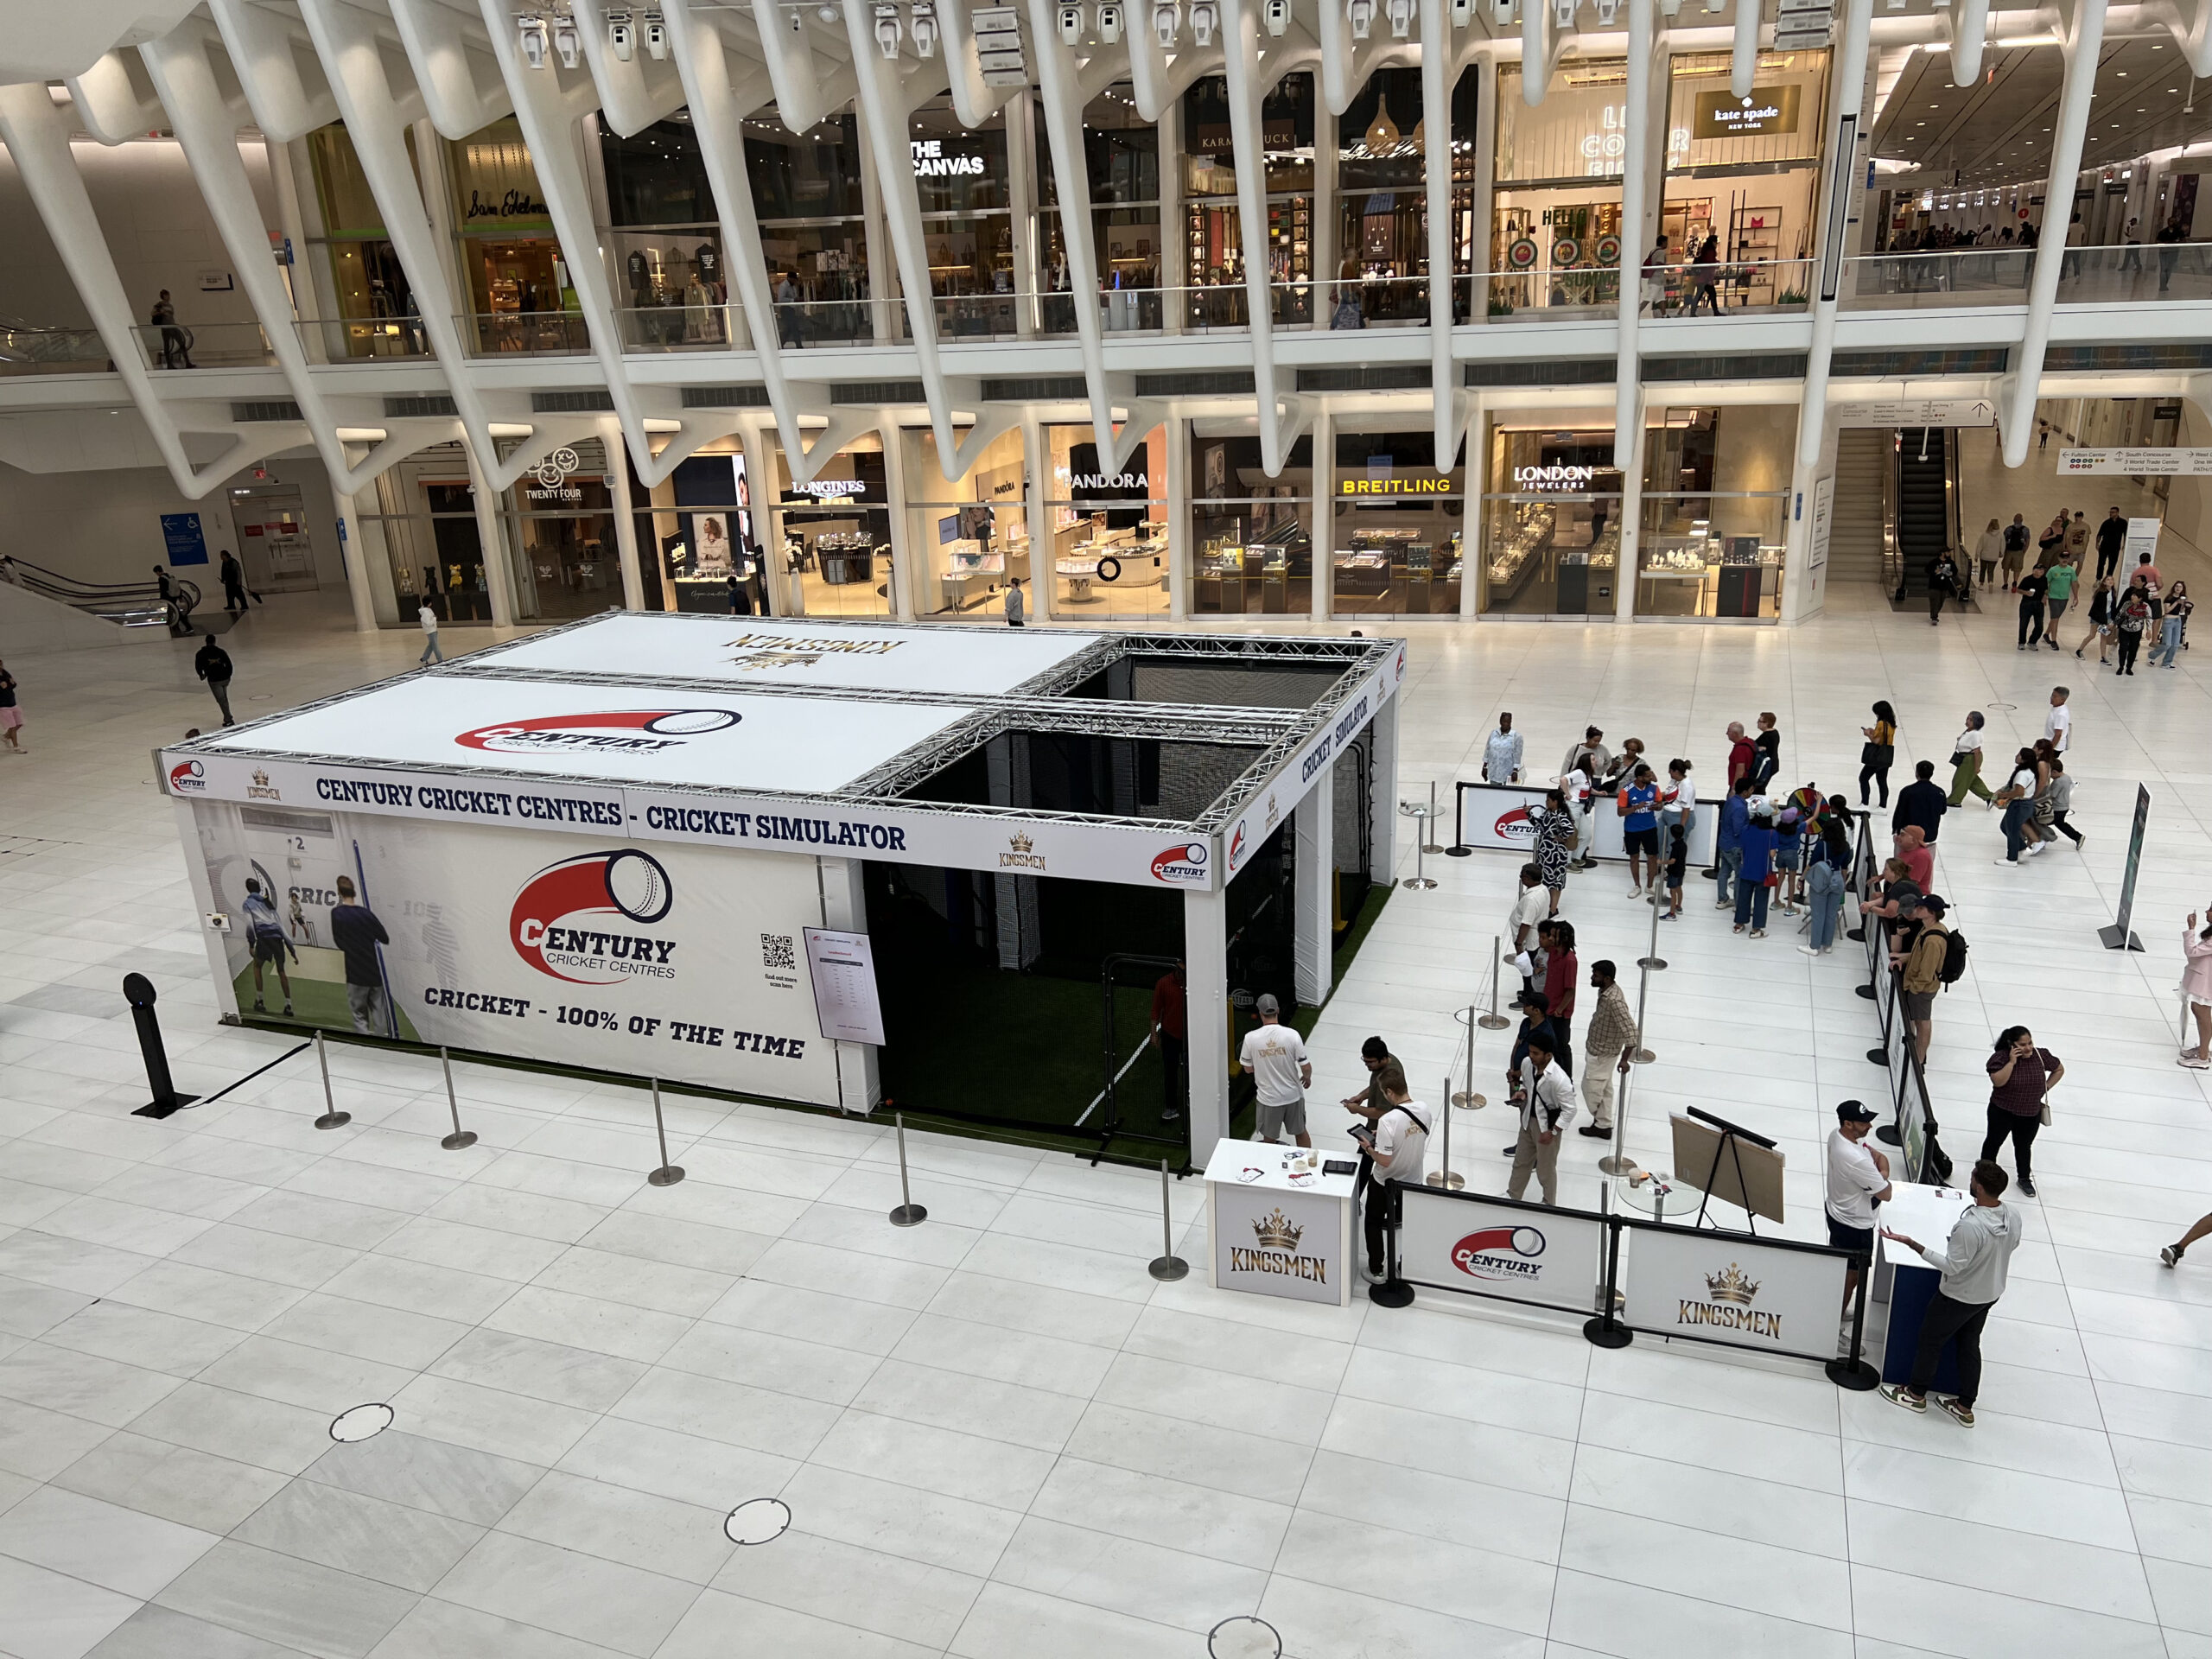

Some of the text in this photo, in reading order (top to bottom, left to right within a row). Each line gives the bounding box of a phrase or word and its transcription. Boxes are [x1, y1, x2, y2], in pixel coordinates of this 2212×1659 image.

[1714, 105, 1778, 122] kate spade
[1264, 134, 1289, 143] UCK
[910, 140, 942, 158] THE
[912, 156, 984, 176] CANVAS
[467, 190, 498, 218] Sam
[1542, 208, 1587, 226] HELLO
[1065, 474, 1148, 489] PANDORA
[1514, 466, 1592, 481] LONDON
[525, 489, 581, 499] TWENTY FOUR
[791, 480, 866, 493] LONGINES
[994, 481, 1014, 495] PANDORA
[1343, 480, 1450, 493] BREITLING
[1522, 482, 1585, 491] JEWELERS
[721, 633, 909, 654] KINGSMEN
[474, 728, 688, 750] CENTURY
[1302, 695, 1368, 783] CRICKET SIMULATOR
[173, 776, 206, 786] CENTURY
[247, 786, 282, 801] KINGSMEN
[316, 778, 413, 806] CENTURY
[418, 786, 512, 816] CRICKET
[517, 795, 622, 825] CENTRES
[646, 805, 750, 836] CRICKET
[757, 815, 906, 850] SIMULATOR
[1497, 823, 1540, 833] CENTUR
[296, 836, 304, 850] 2
[999, 852, 1046, 871] KINGSMEN
[1154, 862, 1206, 876] CENTURY
[519, 918, 676, 964] CENTURY
[546, 952, 676, 979] CRICKET CENTRES
[425, 988, 531, 1018] CRICKET
[556, 1006, 619, 1031] 100%
[627, 1016, 661, 1037] OF
[670, 1021, 724, 1046] THE
[734, 1031, 805, 1059] TIME
[1230, 1246, 1326, 1284] KINGSMEN
[1455, 1249, 1542, 1274] CENTURY
[1469, 1264, 1540, 1281] CRICKET CENTRES
[1677, 1300, 1782, 1339] KINGSMEN
